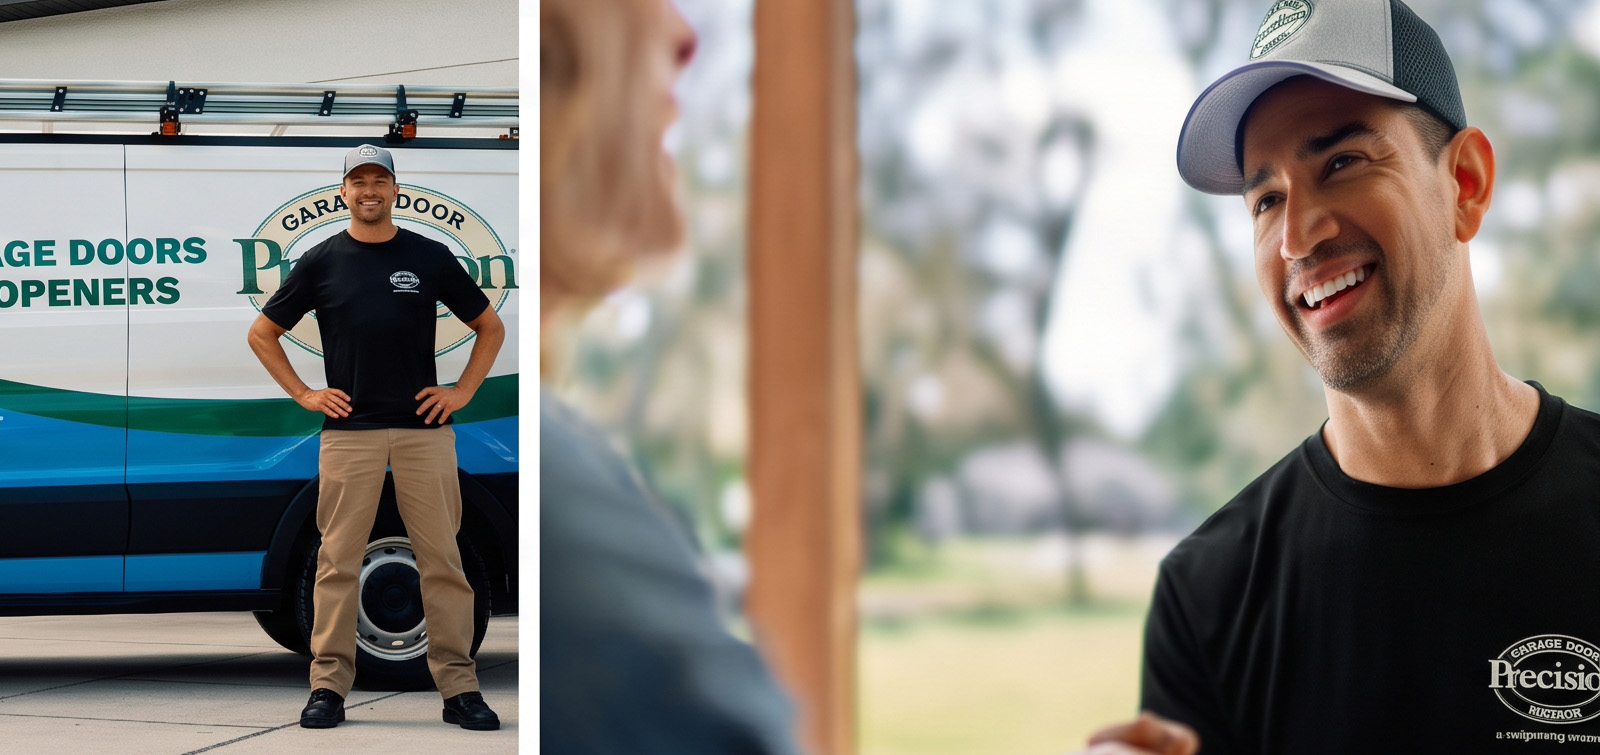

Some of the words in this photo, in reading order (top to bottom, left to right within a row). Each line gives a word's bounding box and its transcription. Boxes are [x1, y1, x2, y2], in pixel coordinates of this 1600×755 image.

[281, 194, 349, 232] GARA
[394, 193, 466, 230] DOOR
[69, 236, 208, 266] DOORS
[1566, 641, 1600, 661] DOOR
